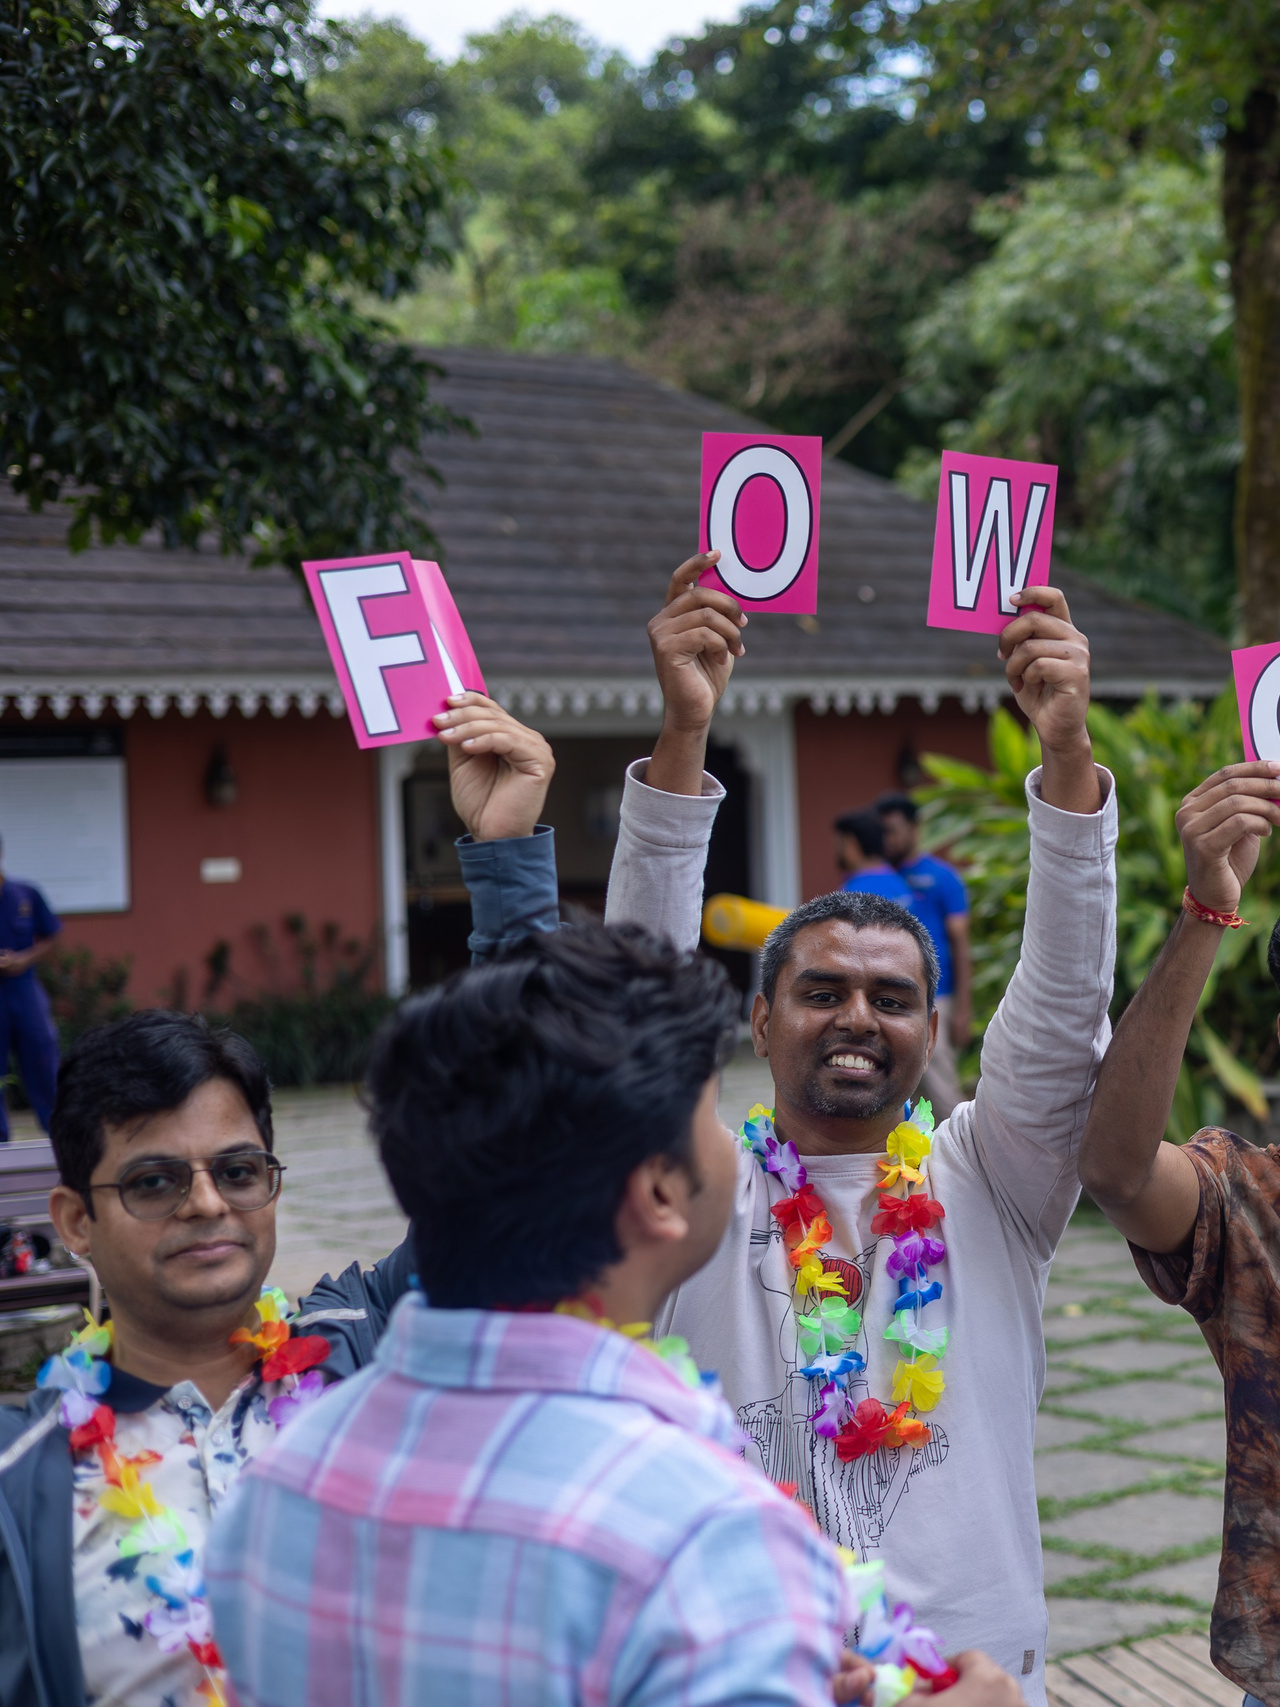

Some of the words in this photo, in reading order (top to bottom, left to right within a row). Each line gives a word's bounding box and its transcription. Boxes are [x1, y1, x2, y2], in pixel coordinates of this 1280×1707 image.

[707, 443, 814, 601] O
[948, 470, 1051, 617] W
[318, 561, 428, 738] F
